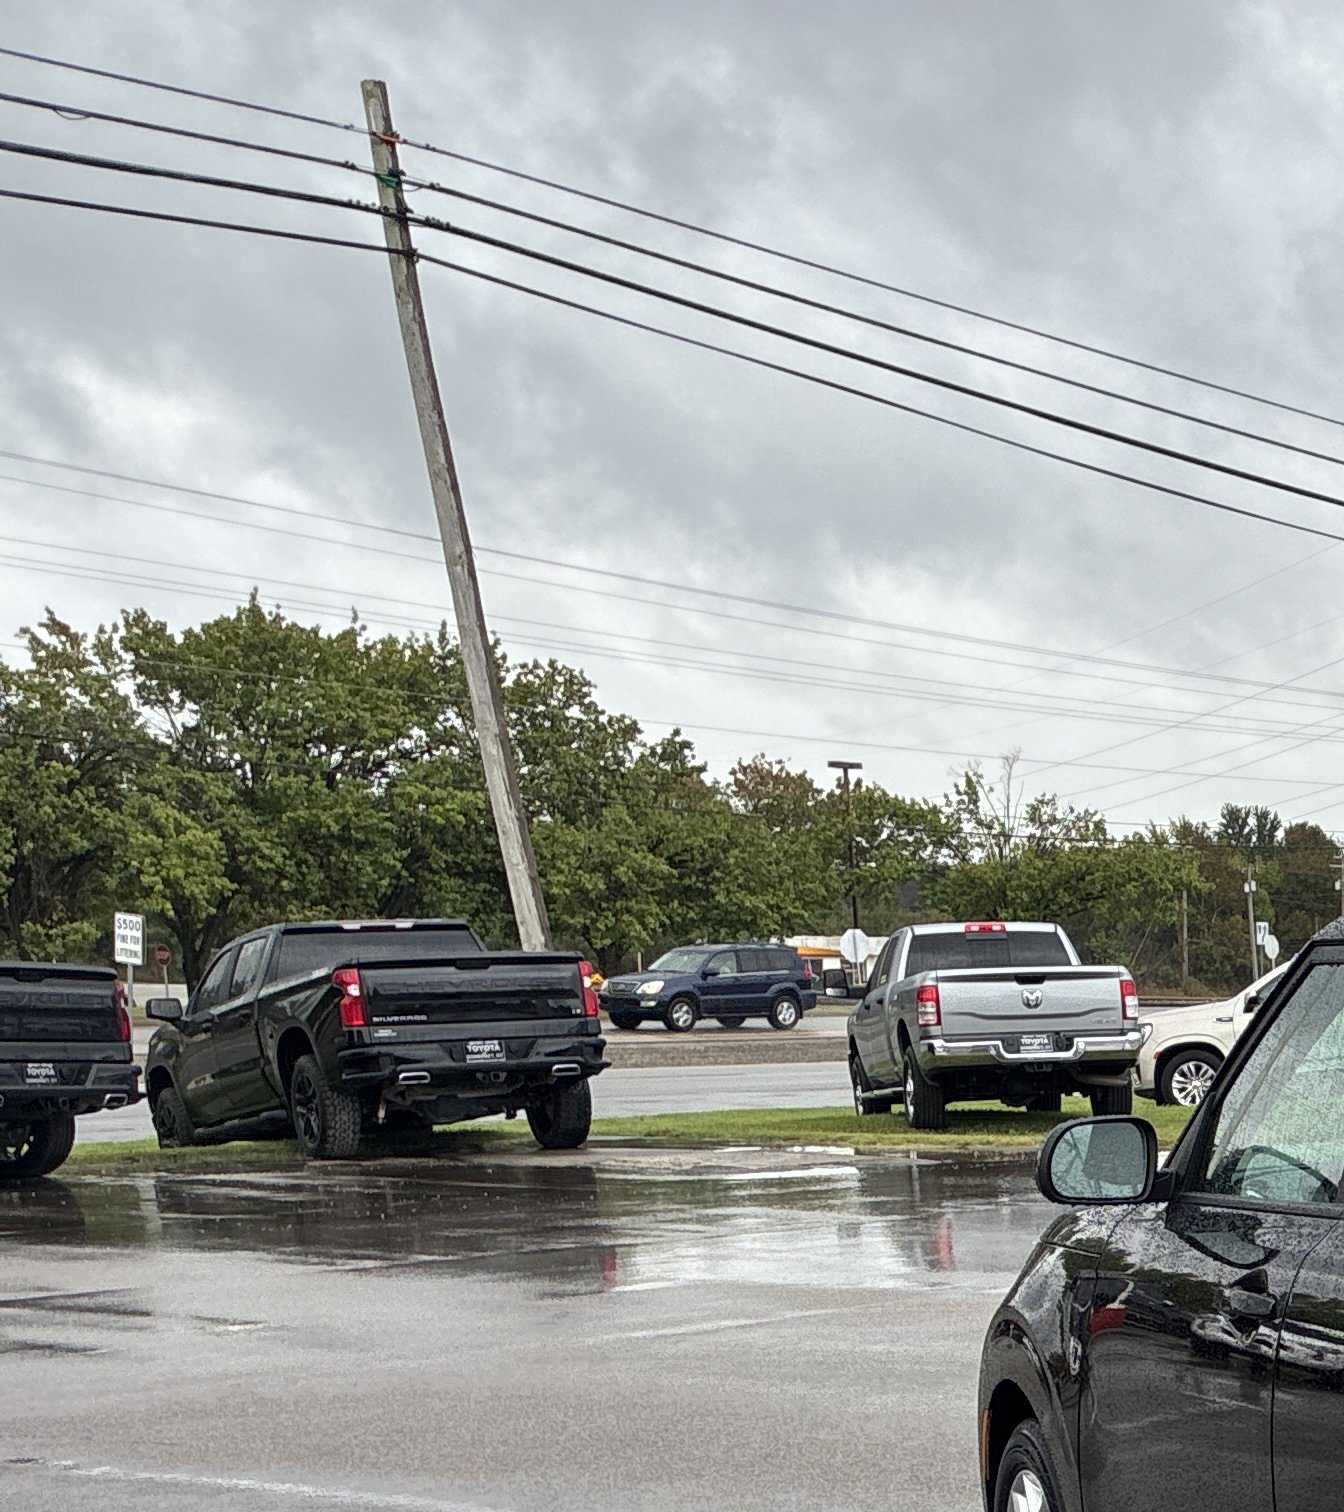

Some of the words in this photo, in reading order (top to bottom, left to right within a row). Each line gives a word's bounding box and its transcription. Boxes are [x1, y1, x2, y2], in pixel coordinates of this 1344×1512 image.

[117, 918, 141, 931] $500
[467, 1044, 501, 1053] TOYOTA
[26, 1068, 56, 1076] TOYOTA
